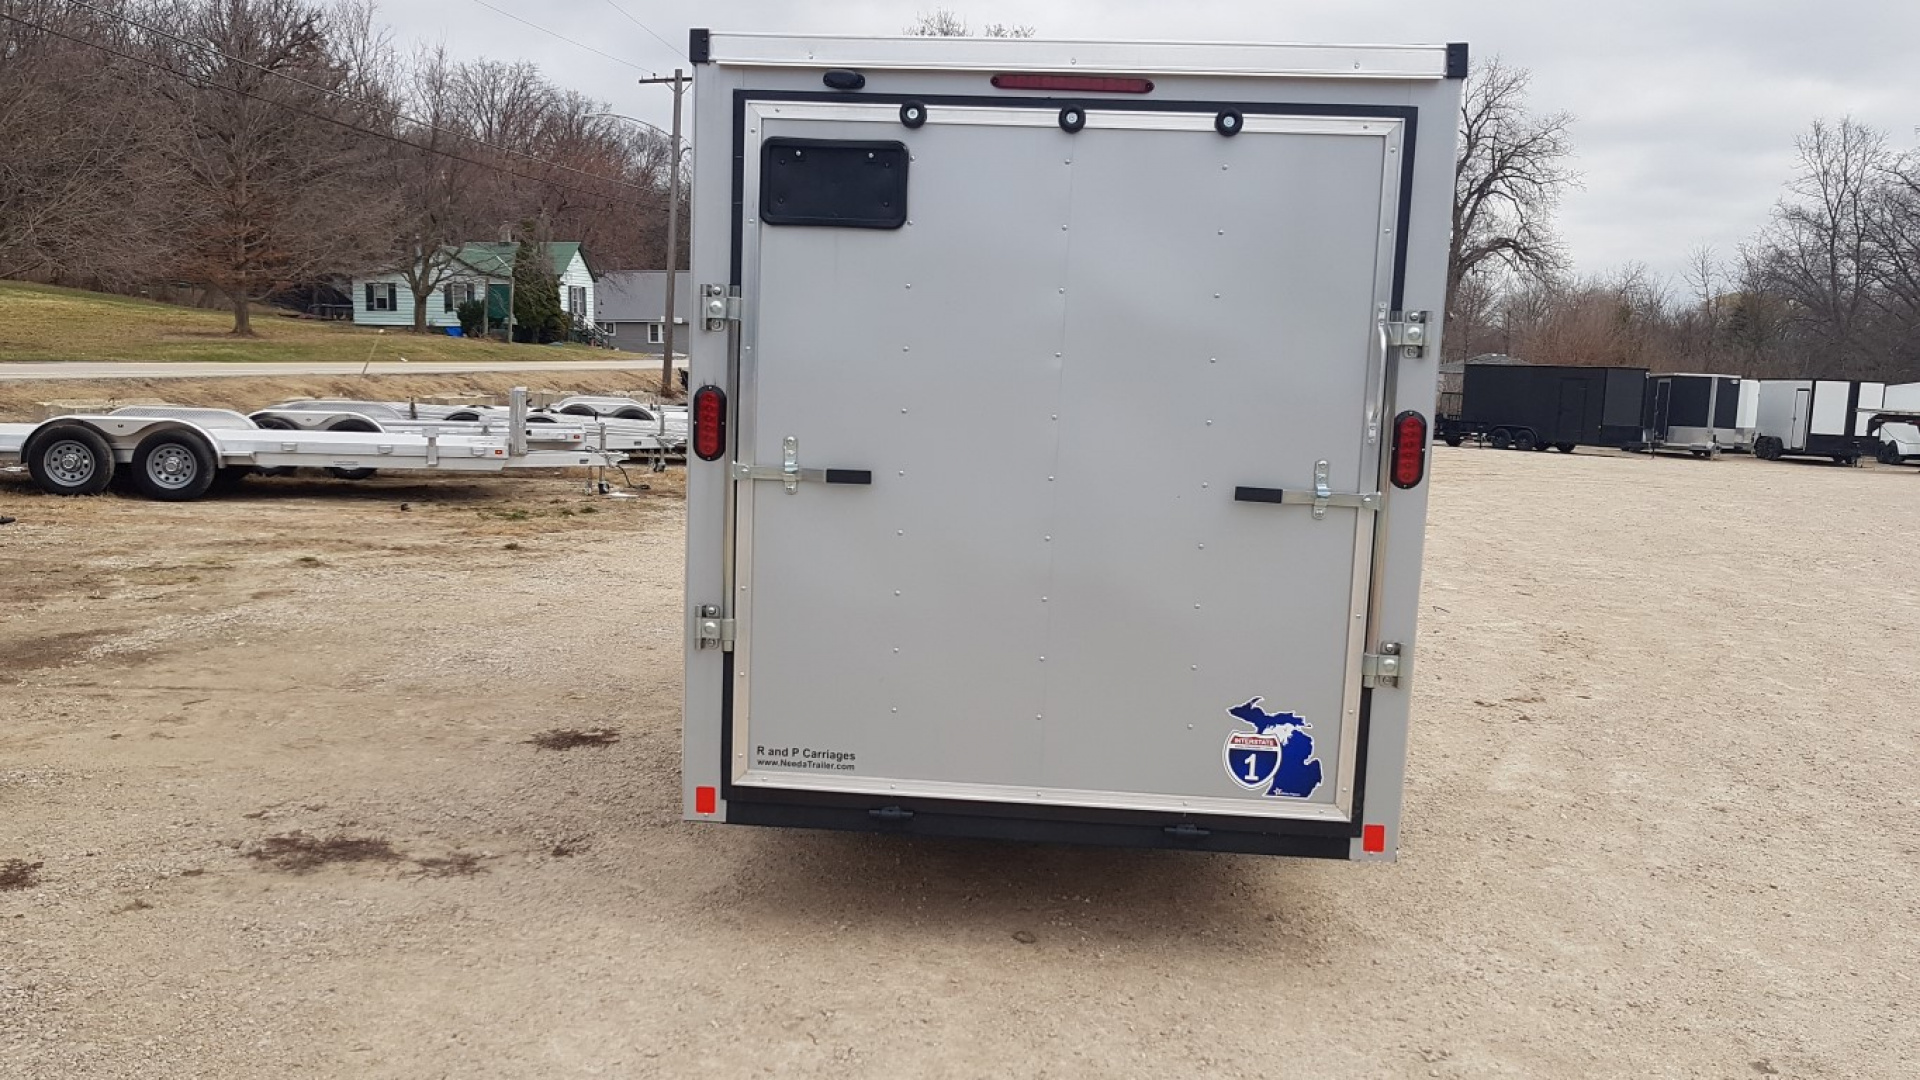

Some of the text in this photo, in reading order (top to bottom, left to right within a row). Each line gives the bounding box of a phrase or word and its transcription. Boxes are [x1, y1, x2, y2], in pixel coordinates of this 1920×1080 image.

[1234, 738, 1273, 746] INTERSTATE
[756, 746, 856, 762] R and P Carriages
[757, 759, 855, 770] www.NeedaTrailer.com
[1244, 753, 1259, 780] 1
